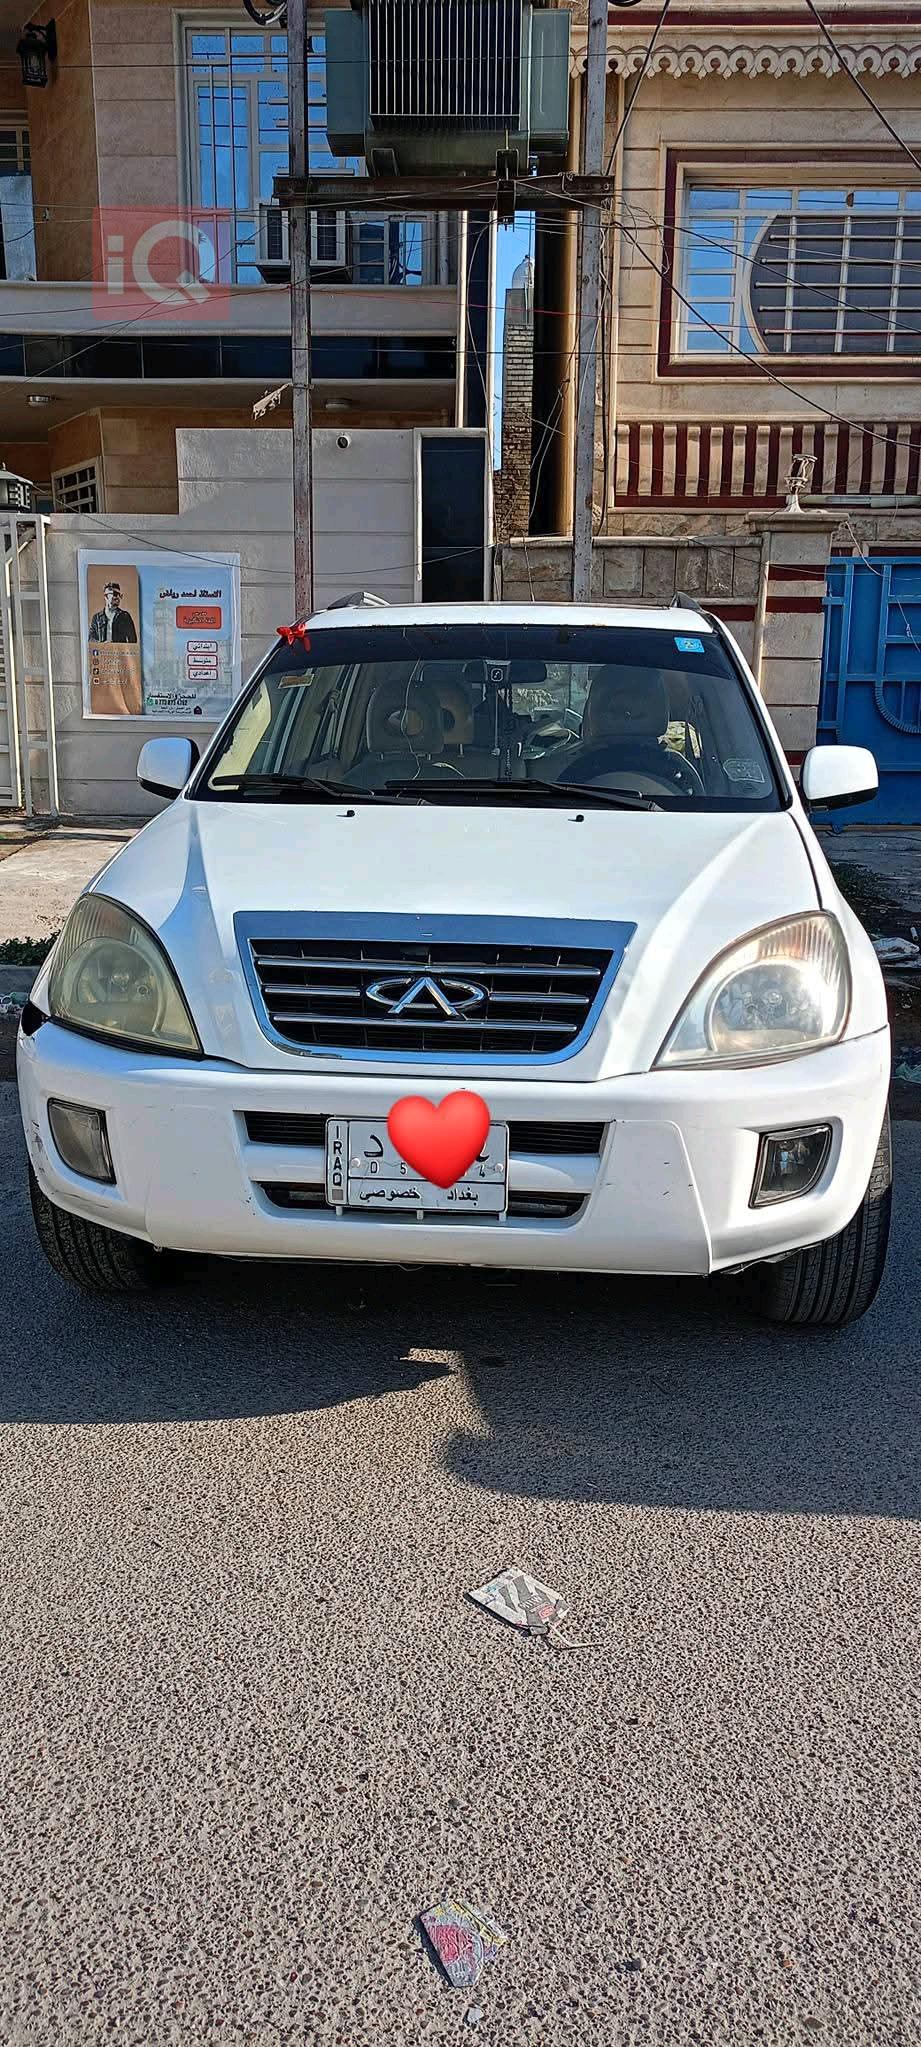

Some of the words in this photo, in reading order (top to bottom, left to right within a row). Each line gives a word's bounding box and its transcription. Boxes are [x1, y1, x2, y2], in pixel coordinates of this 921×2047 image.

[332, 1125, 343, 1187] IRAQ
[359, 1187, 421, 1203] خصوصي
[446, 1186, 479, 1206] بغداد
